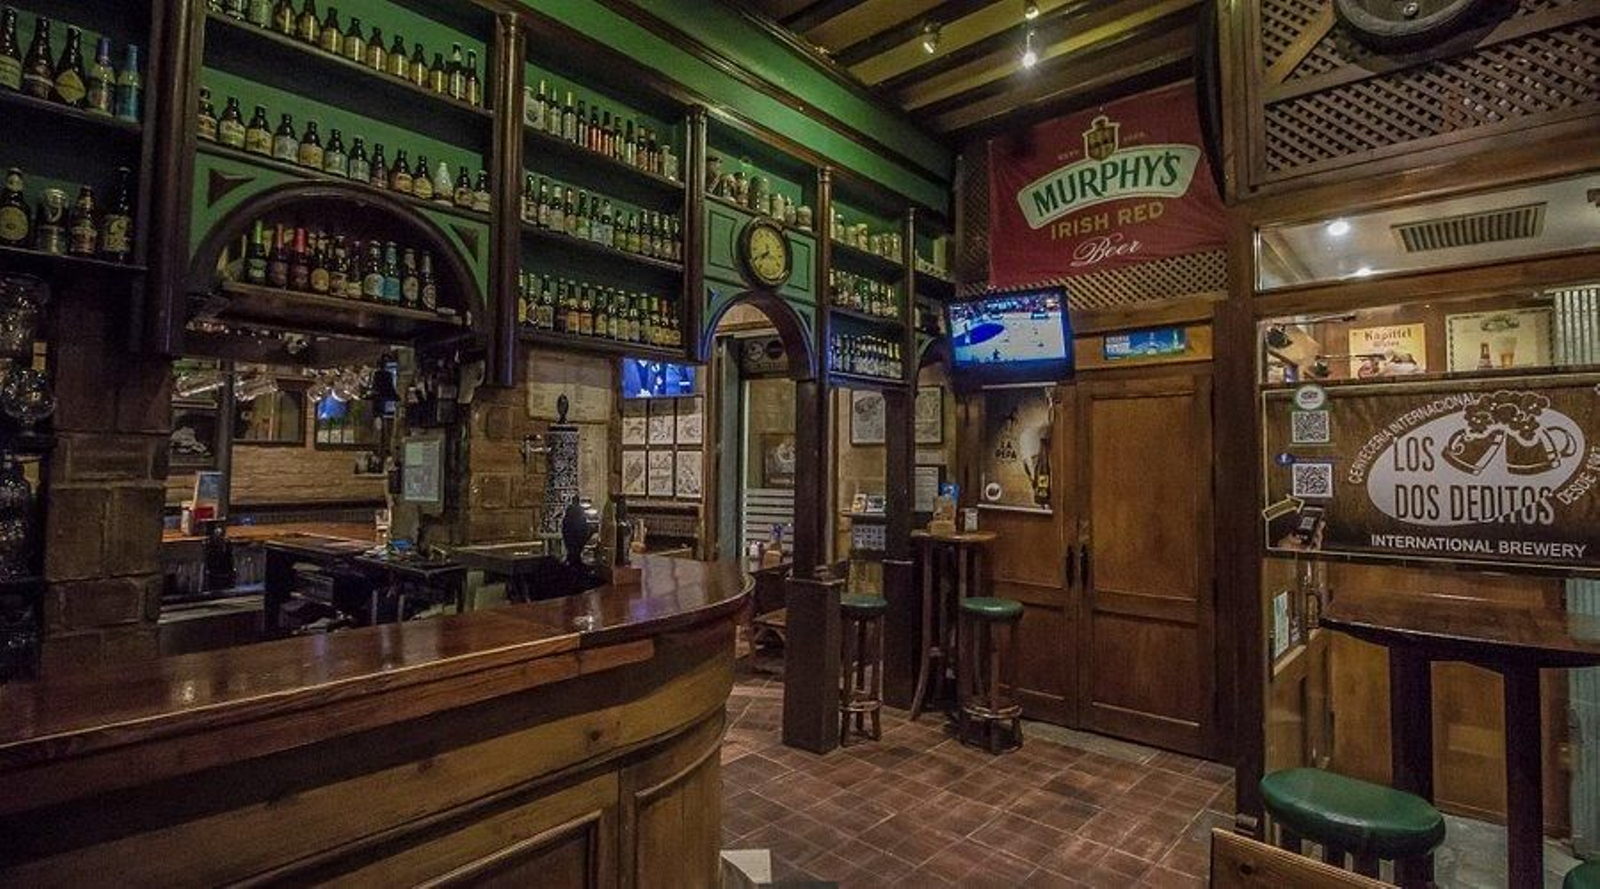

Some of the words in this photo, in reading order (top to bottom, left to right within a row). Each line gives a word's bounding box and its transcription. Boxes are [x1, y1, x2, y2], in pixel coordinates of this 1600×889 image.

[1032, 151, 1181, 217] MURPHY'S
[1051, 212, 1109, 240] IRISH
[1117, 201, 1164, 227] RED
[1070, 232, 1143, 267] Beer
[1393, 436, 1436, 472] LOS
[1395, 484, 1441, 520] DOS
[1450, 485, 1555, 525] DEDITOS
[1371, 533, 1494, 554] INTERNATIONAL
[1499, 539, 1587, 558] BREWERY
